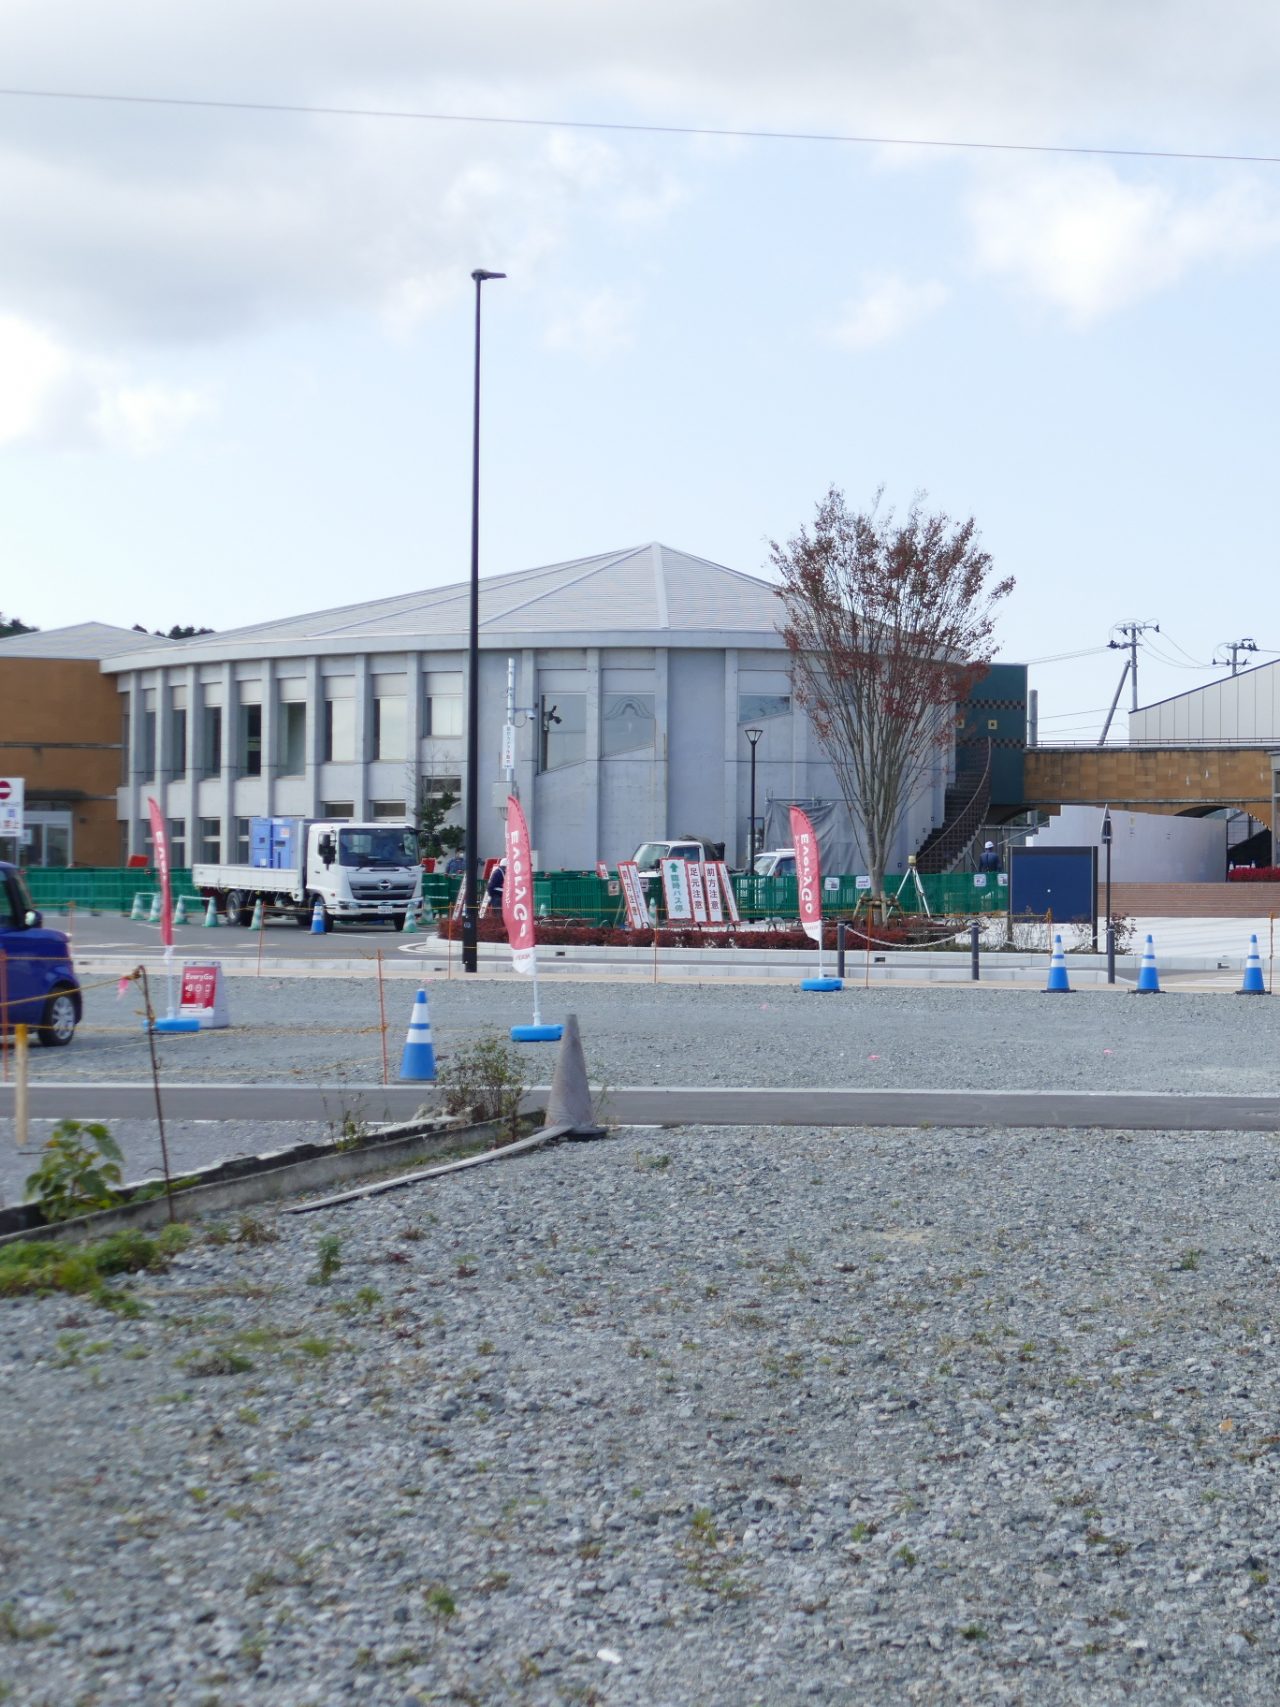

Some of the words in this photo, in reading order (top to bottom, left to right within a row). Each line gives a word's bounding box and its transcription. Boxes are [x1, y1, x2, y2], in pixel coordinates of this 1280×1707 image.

[690, 867, 703, 910] 足元注意
[706, 867, 719, 910] 前方注意
[185, 972, 214, 982] EveryGo
